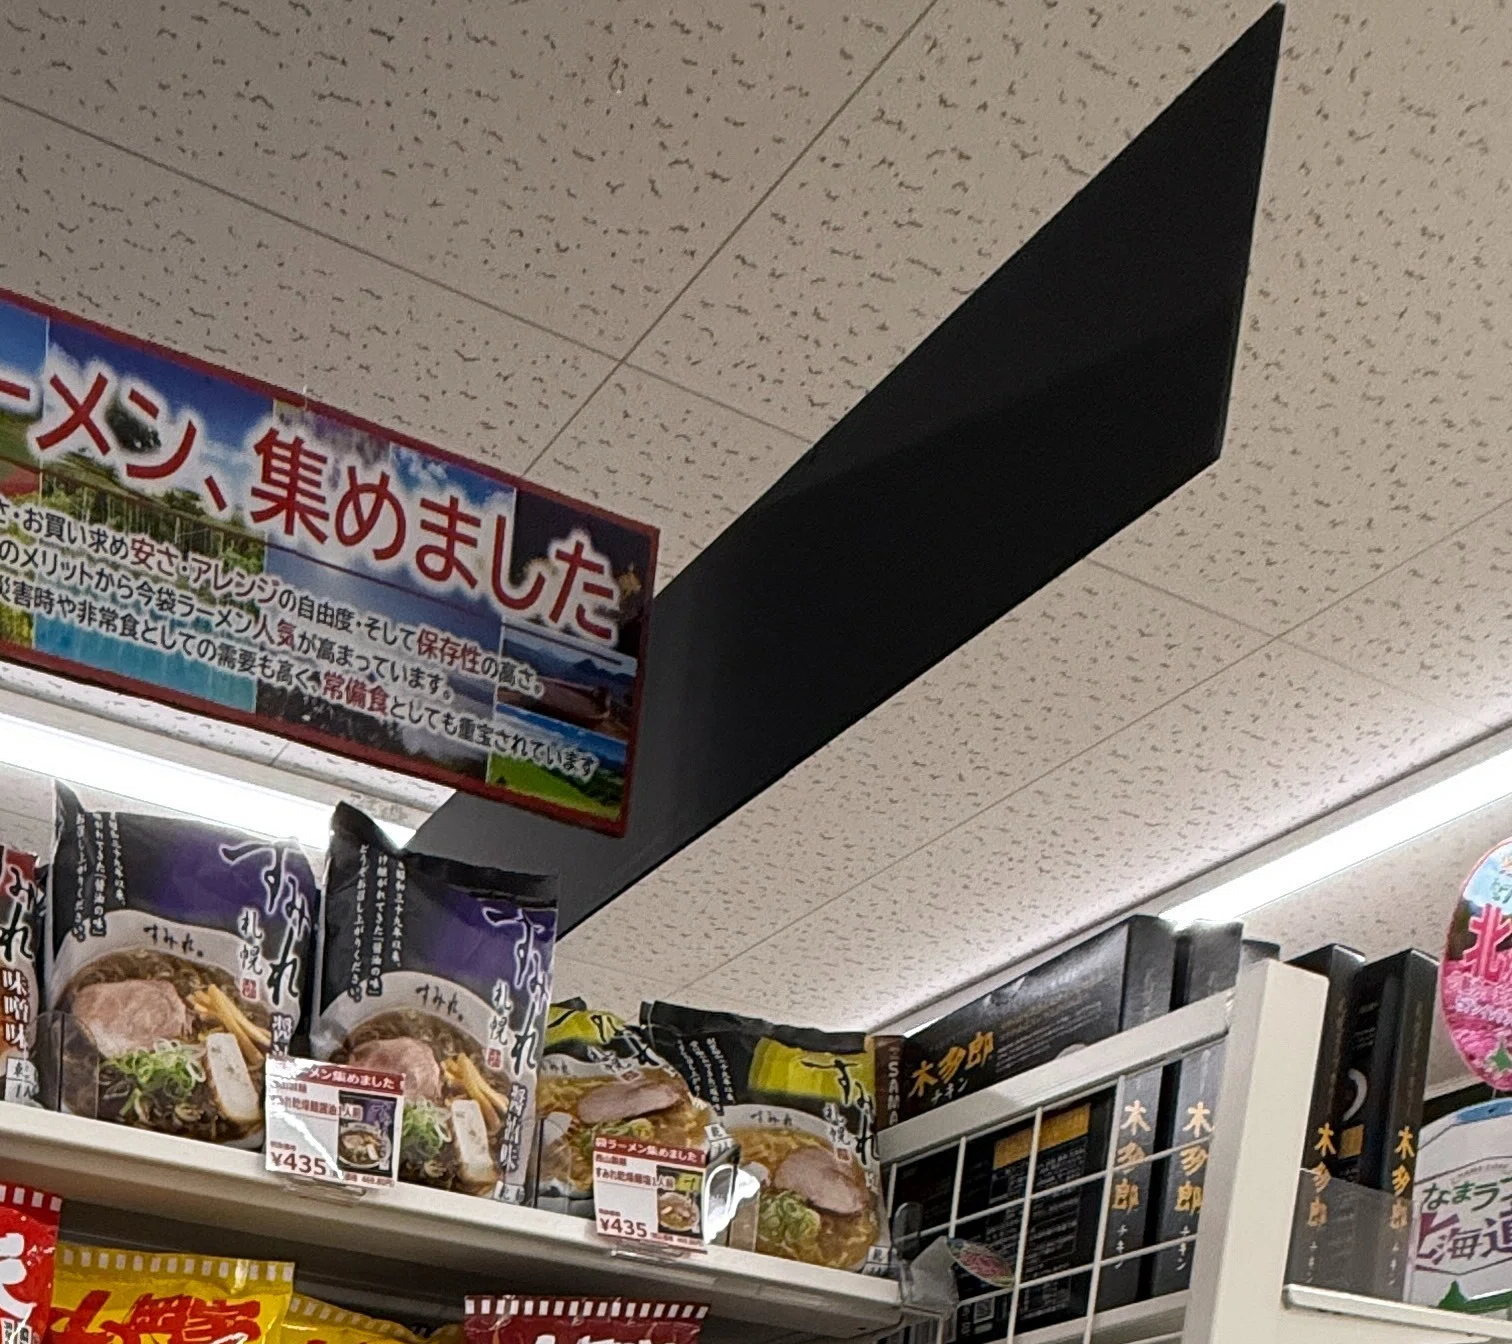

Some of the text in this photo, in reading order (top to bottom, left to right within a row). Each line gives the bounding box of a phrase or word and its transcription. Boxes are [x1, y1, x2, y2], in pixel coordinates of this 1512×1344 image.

[909, 1028, 996, 1100] 木多郎
[270, 1150, 327, 1178] ¥435
[1111, 1099, 1150, 1213] 木多郎
[1173, 1099, 1214, 1214] 木多郎
[599, 1217, 649, 1238] ¥435
